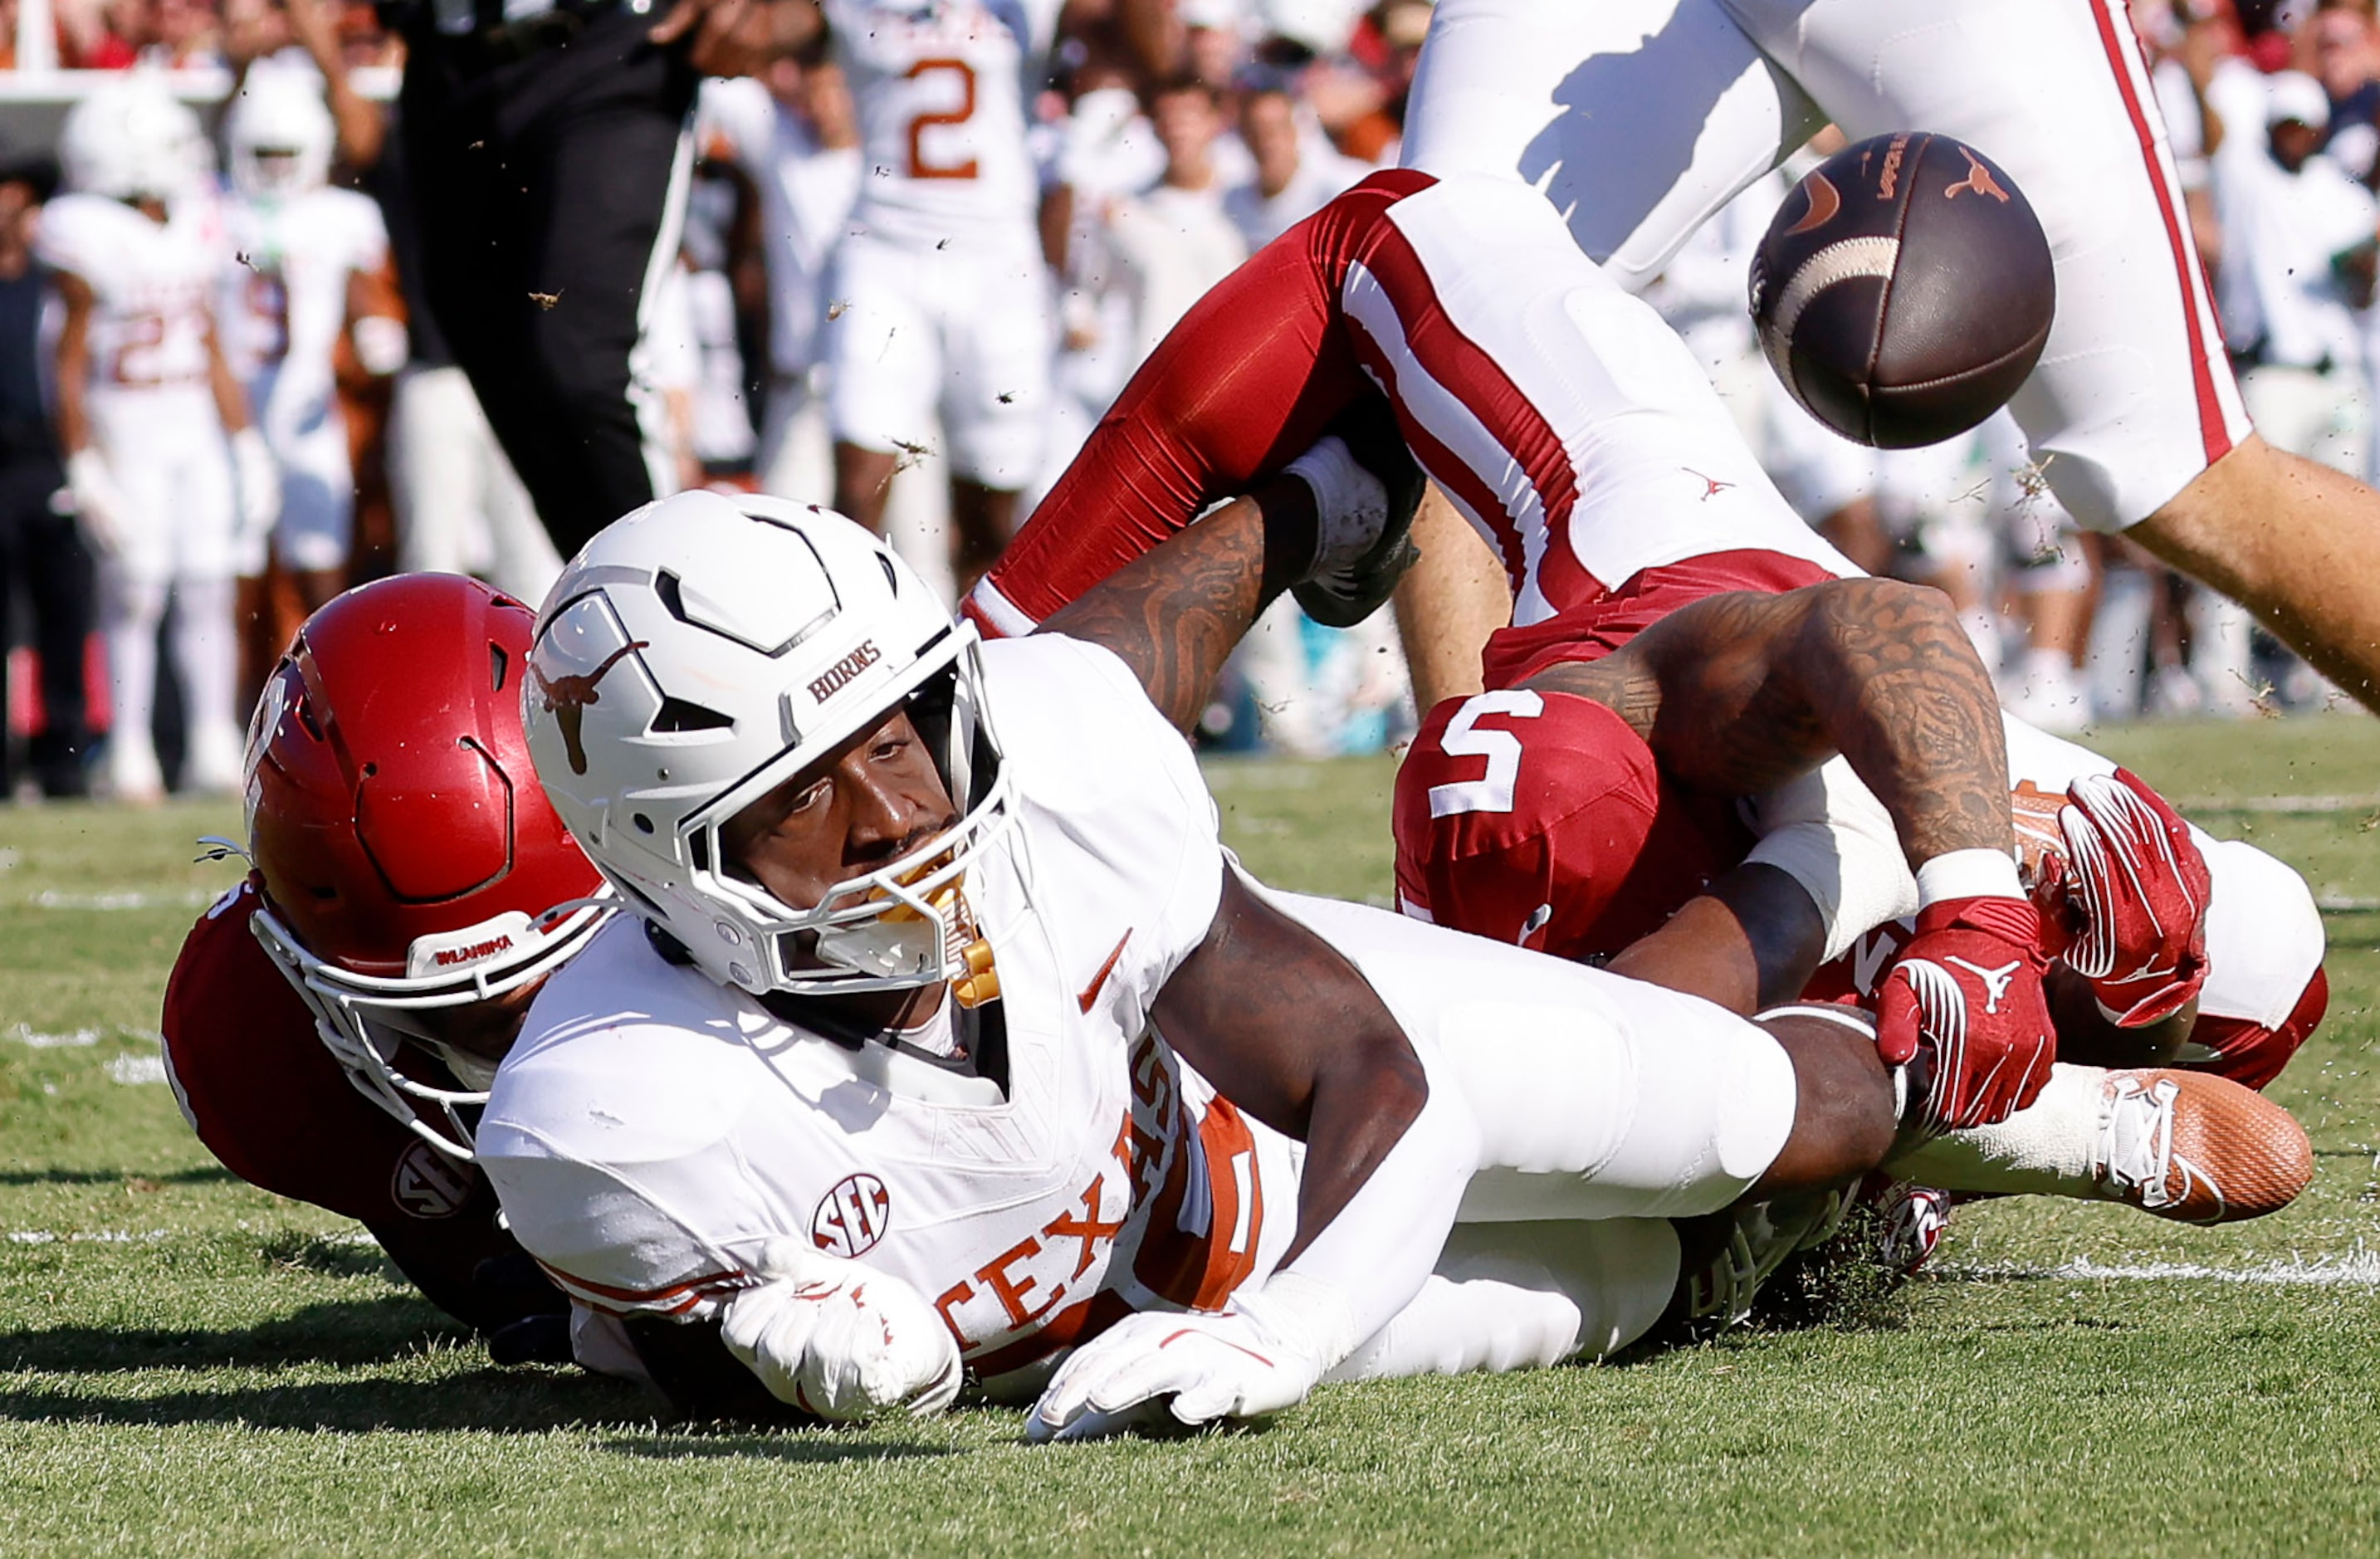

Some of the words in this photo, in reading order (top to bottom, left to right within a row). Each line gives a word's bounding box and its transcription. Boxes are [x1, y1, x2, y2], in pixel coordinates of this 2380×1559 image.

[905, 59, 977, 179] 2
[806, 638, 882, 706] HORNS
[1428, 688, 1544, 819] 5
[813, 1175, 888, 1258] SEC
[935, 1032, 1173, 1352] TEXAS
